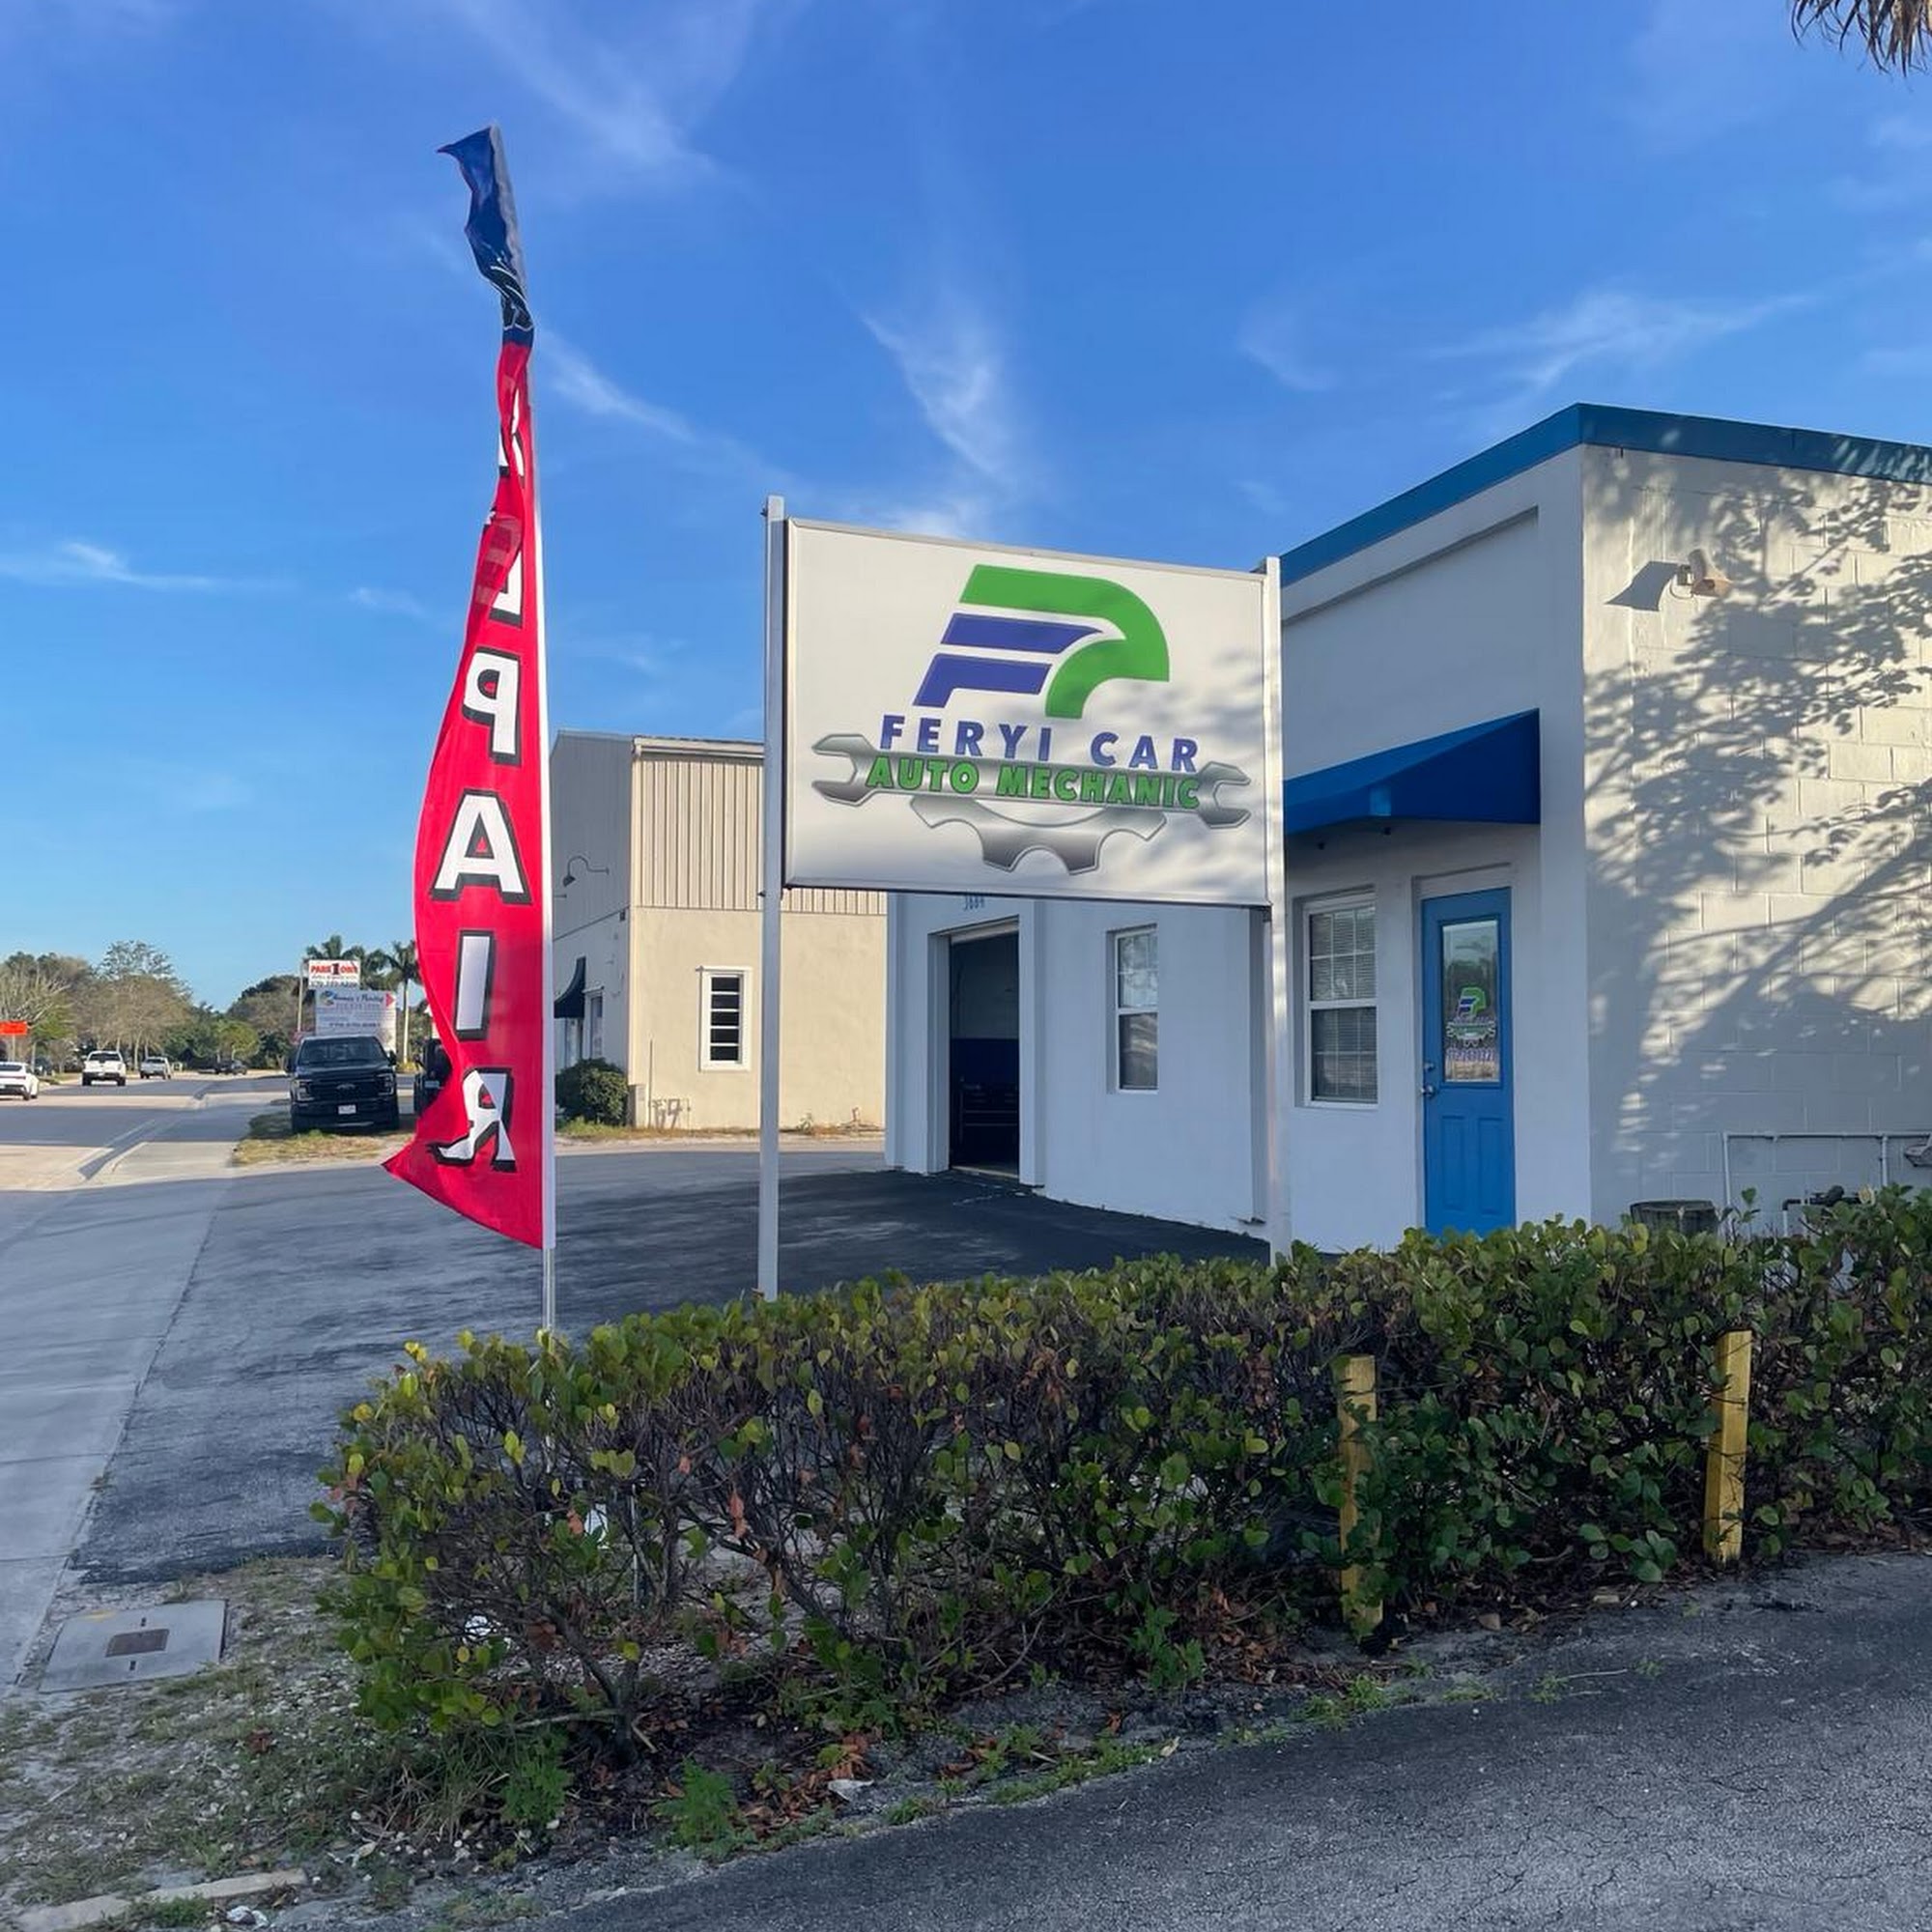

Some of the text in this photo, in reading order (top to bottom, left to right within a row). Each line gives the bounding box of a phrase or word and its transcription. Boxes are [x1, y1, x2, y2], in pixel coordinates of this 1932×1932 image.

[879, 714, 1199, 773] FERYI CAR
[866, 755, 1201, 810] AUTO MECHANIC
